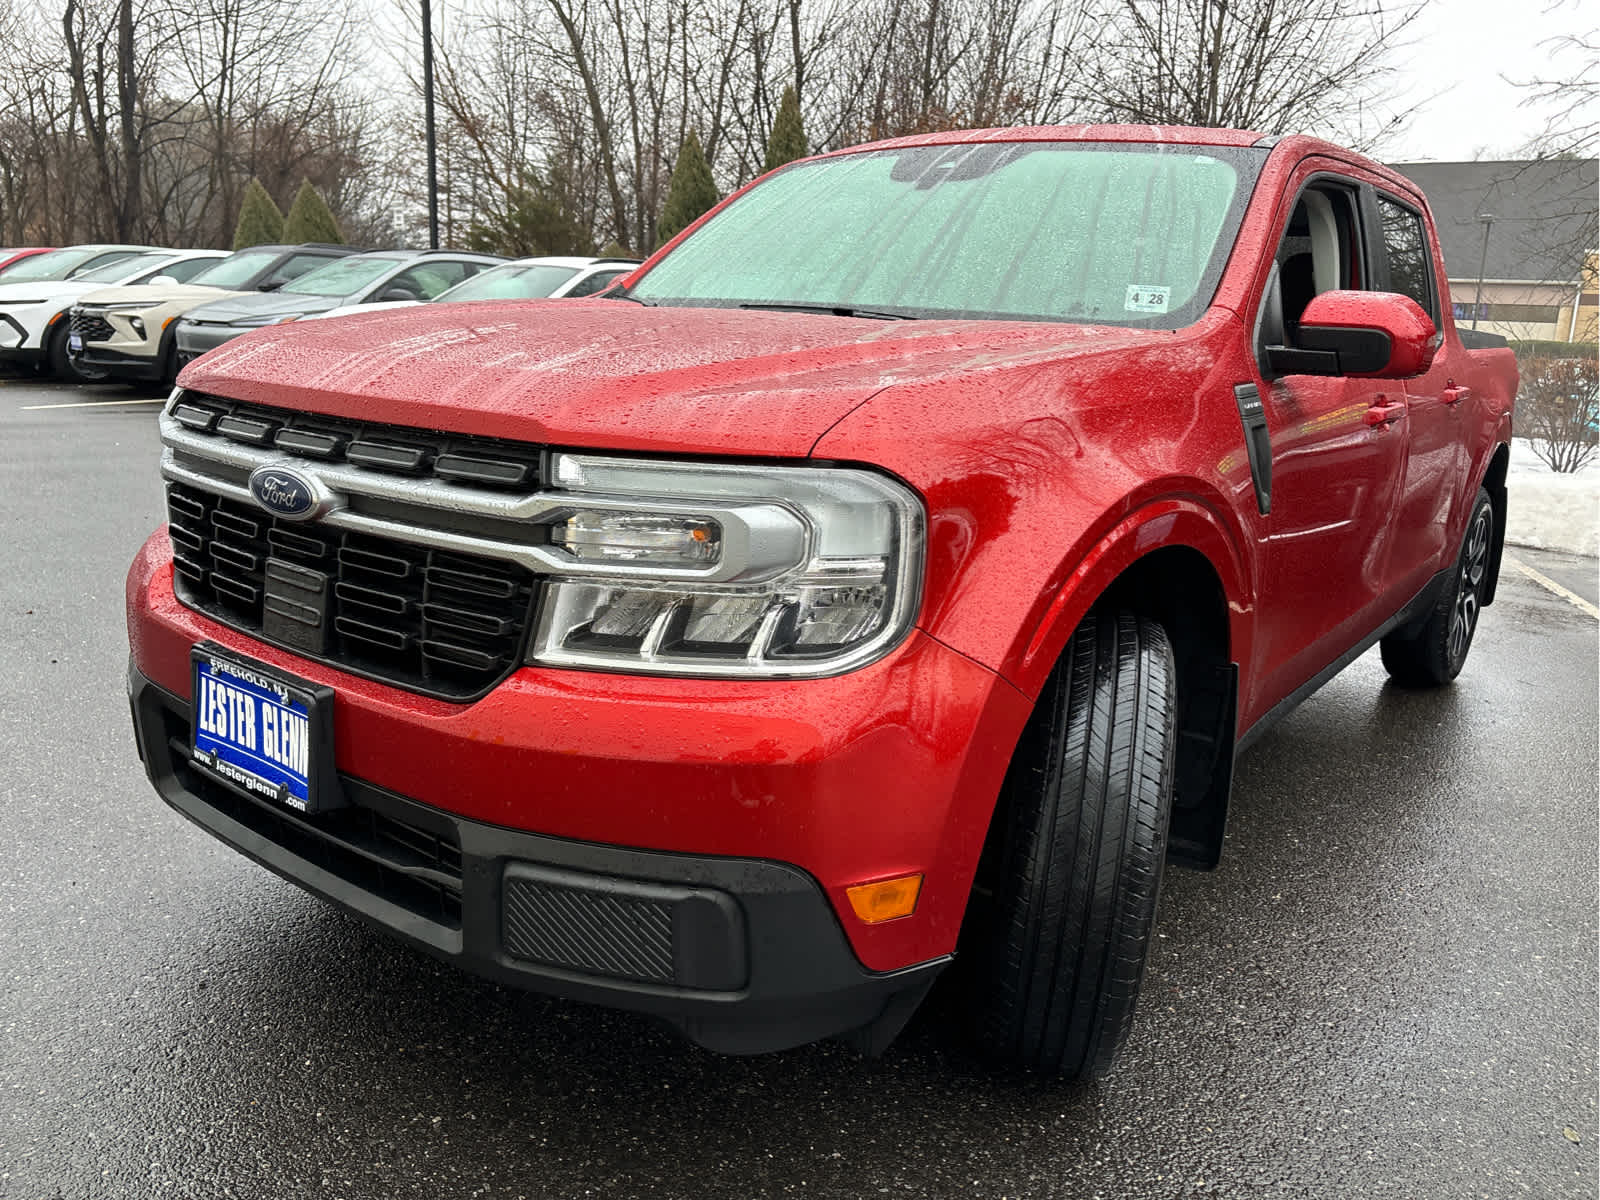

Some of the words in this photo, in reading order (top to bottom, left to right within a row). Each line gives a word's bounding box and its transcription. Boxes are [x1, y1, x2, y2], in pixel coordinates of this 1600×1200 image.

[1131, 292, 1140, 303] 4
[1148, 293, 1164, 305] 28
[261, 476, 297, 508] Ford
[199, 676, 257, 751] LESTER
[262, 701, 309, 778] GLENN
